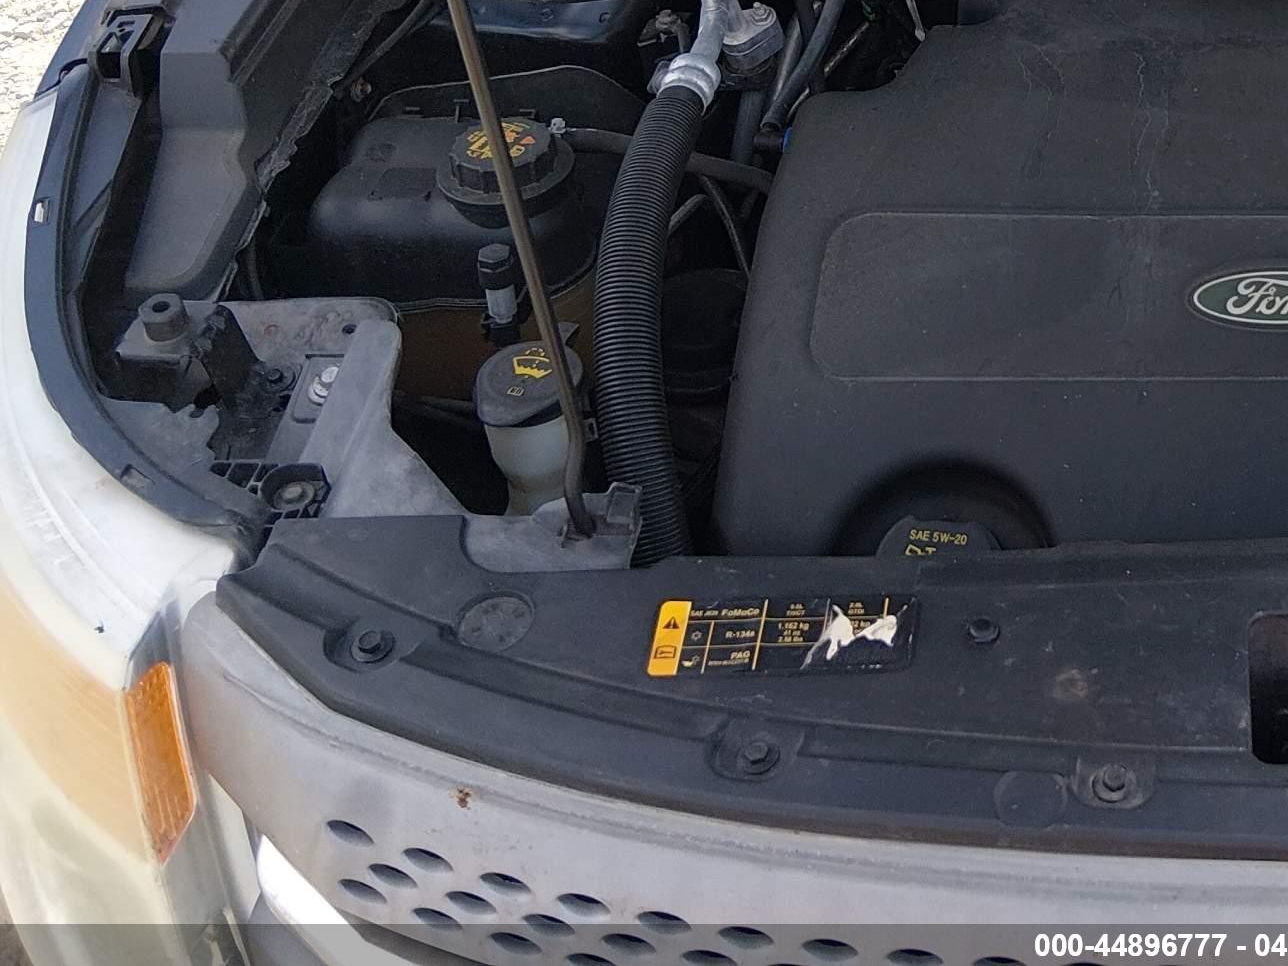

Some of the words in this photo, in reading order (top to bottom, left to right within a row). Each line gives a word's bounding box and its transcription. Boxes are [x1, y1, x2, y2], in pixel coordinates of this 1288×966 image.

[909, 529, 931, 541] SAE
[932, 531, 968, 546] 5W-20
[721, 607, 760, 618] FoMoCo
[799, 622, 810, 631] kg
[725, 629, 756, 639] R-134a
